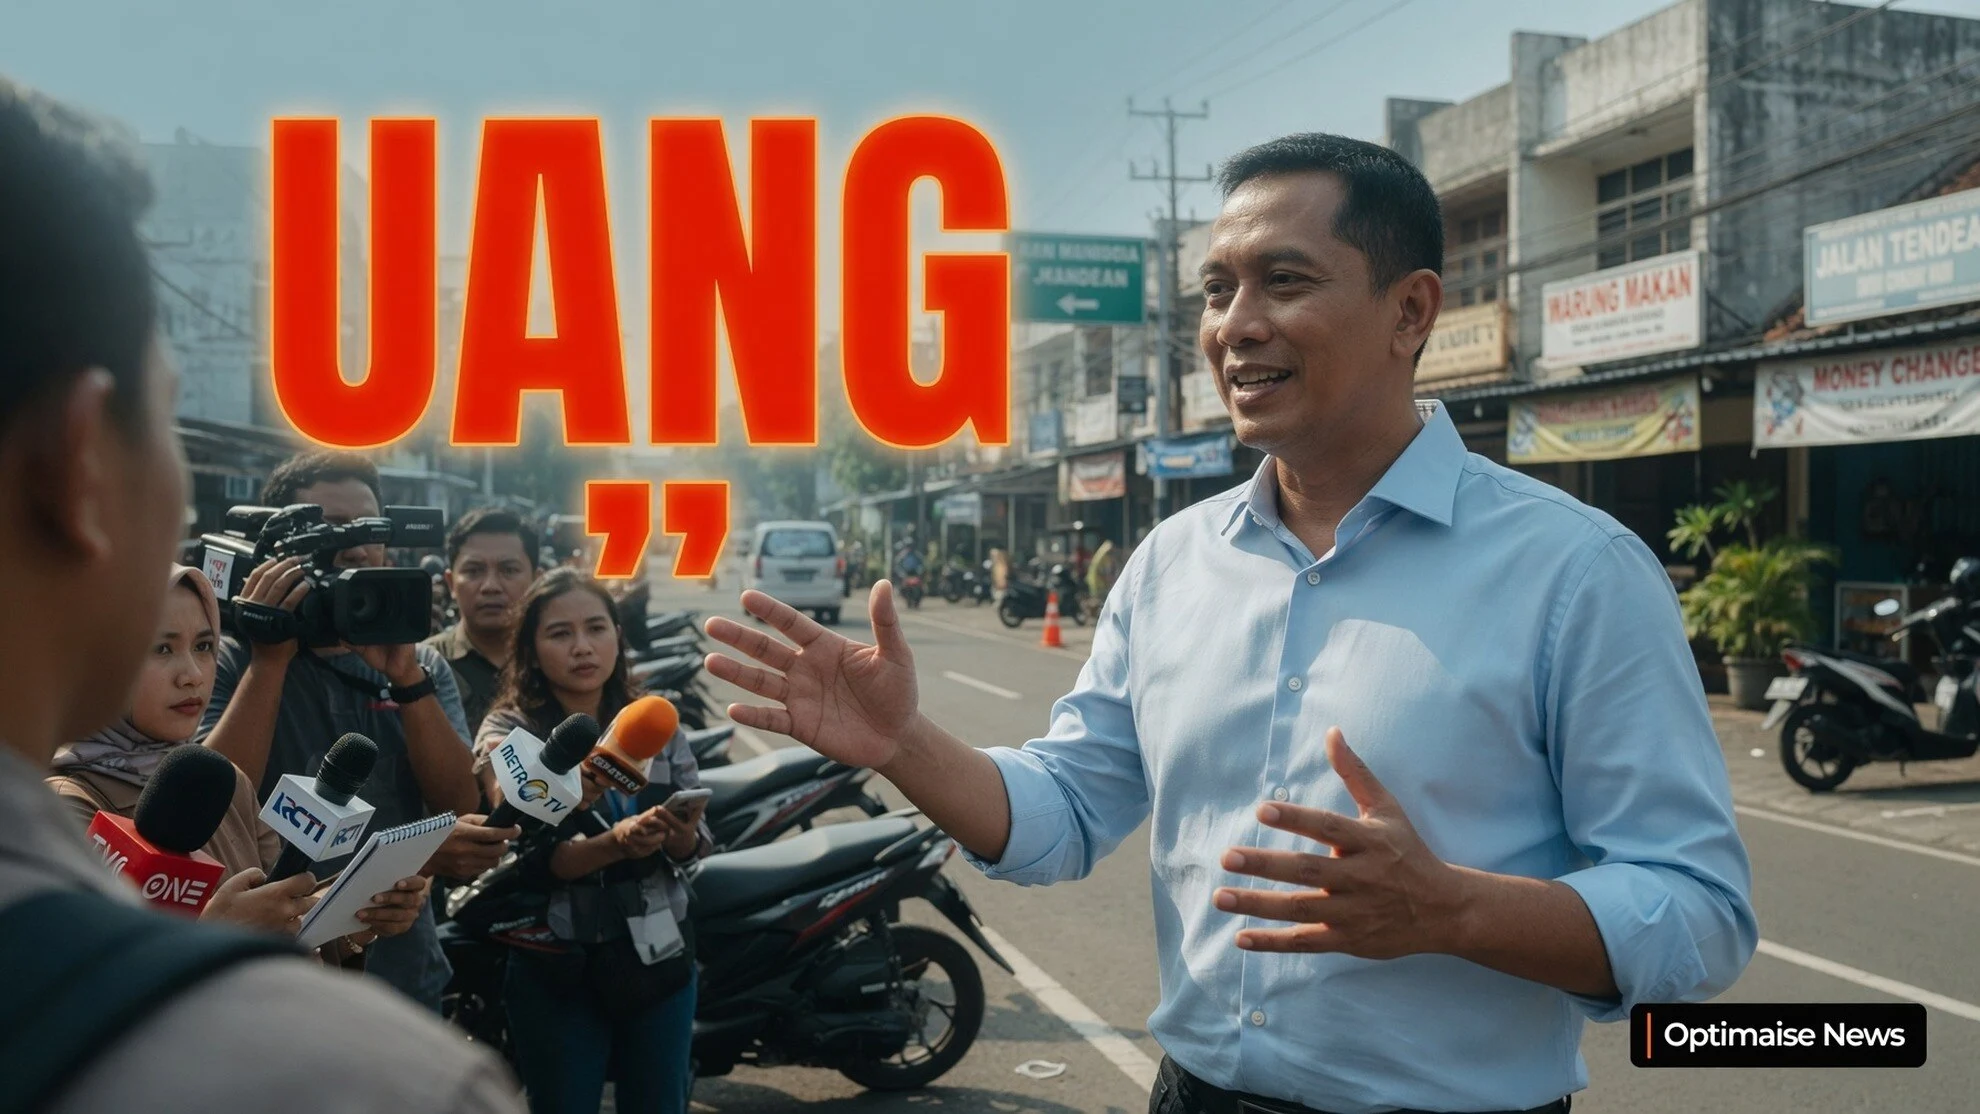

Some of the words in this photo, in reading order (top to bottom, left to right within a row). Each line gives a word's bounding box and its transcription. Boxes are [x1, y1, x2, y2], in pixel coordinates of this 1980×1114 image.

[1816, 233, 1884, 278] JALAN
[1547, 280, 1620, 325] WARUNG
[1625, 261, 1692, 310] MAKAN
[1813, 360, 1884, 393] MONEY
[543, 796, 567, 813] TV
[141, 873, 209, 906] ONE
